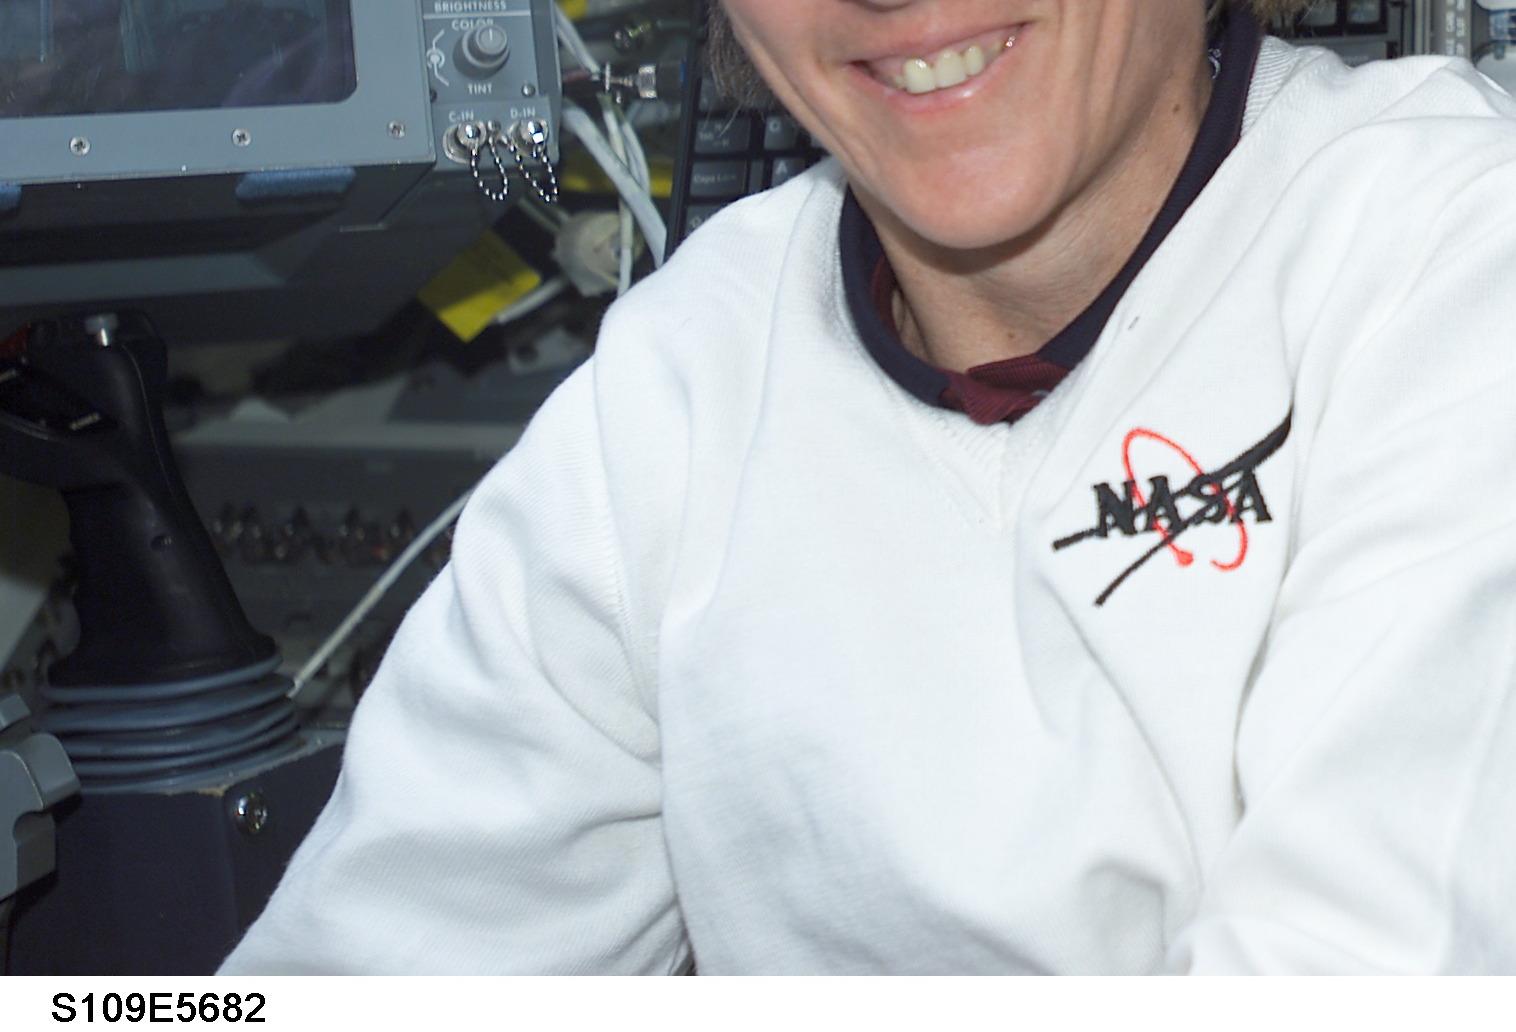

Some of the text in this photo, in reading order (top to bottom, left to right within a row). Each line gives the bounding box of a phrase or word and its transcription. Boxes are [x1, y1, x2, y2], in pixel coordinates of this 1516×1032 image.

[434, 0, 507, 13] BRIGHTNESS
[467, 84, 493, 95] TINT
[448, 110, 474, 121] C-IN
[510, 107, 536, 119] D-IN
